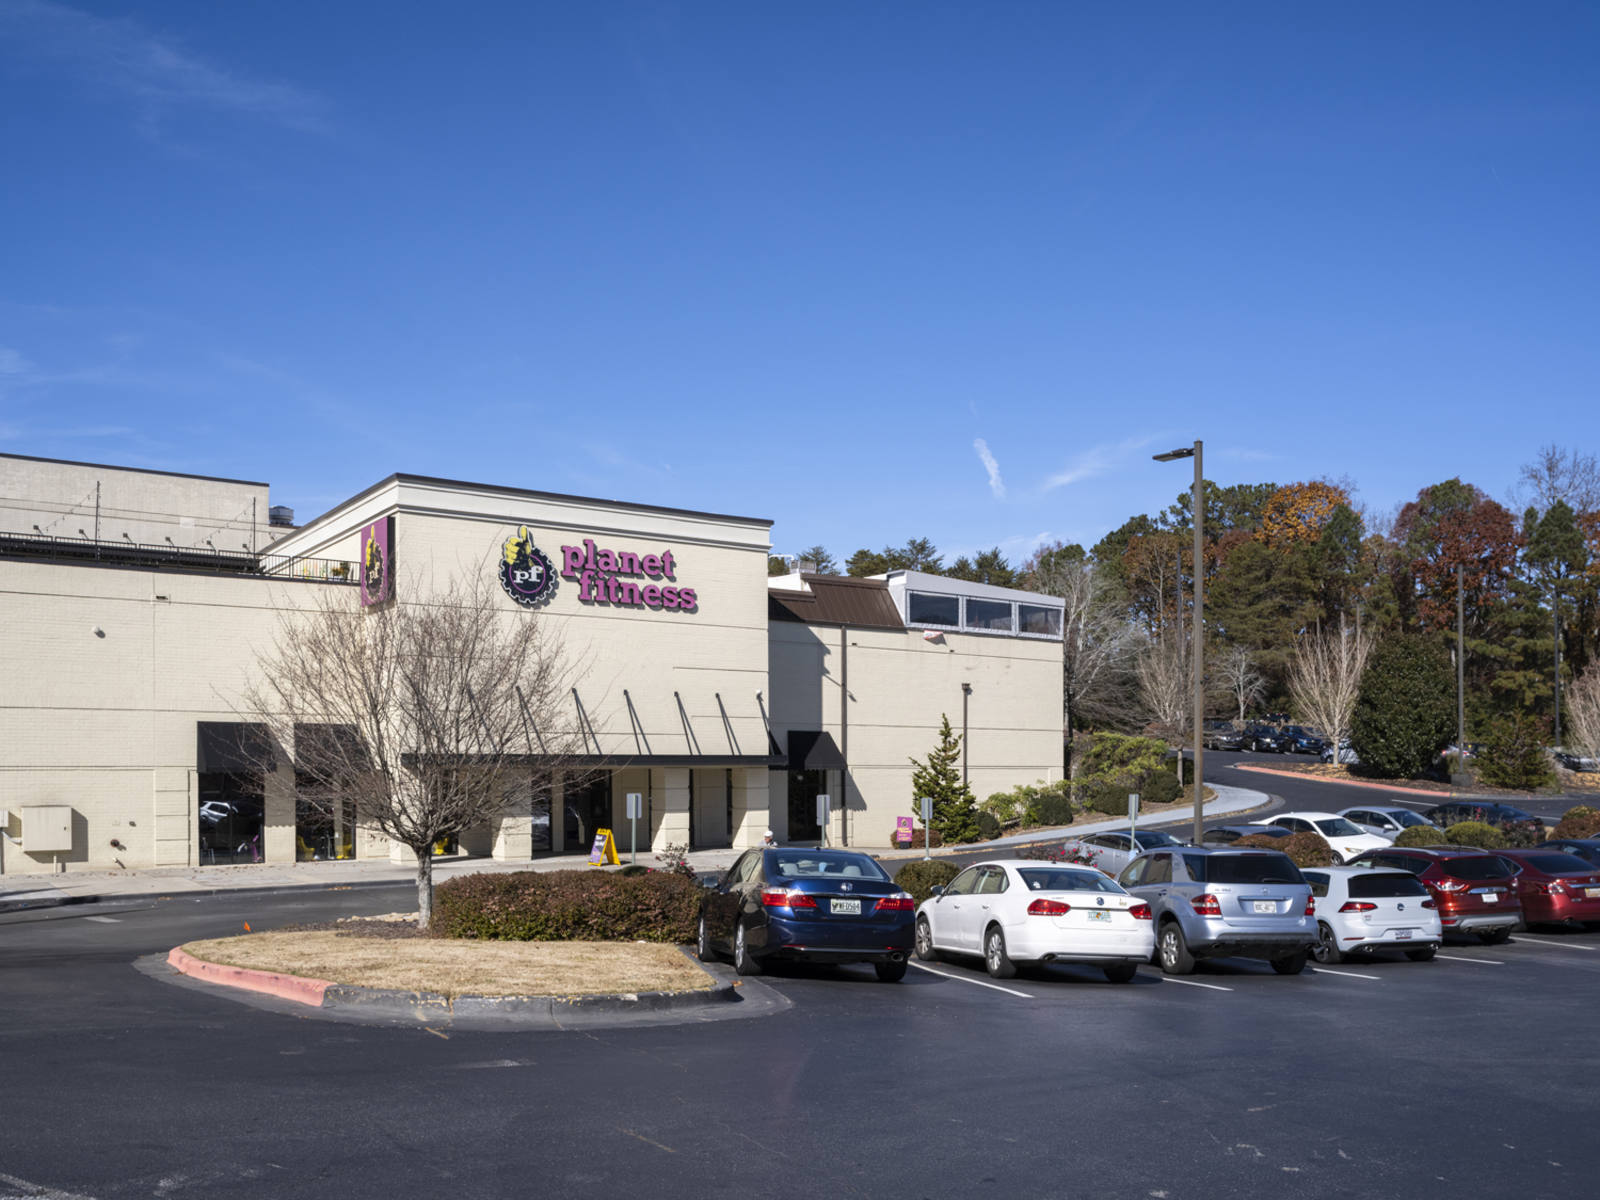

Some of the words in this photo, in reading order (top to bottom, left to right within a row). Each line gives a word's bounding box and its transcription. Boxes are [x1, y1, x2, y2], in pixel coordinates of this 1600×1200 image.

[513, 565, 545, 584] pf
[561, 538, 674, 577] planet
[578, 570, 697, 609] fitness
